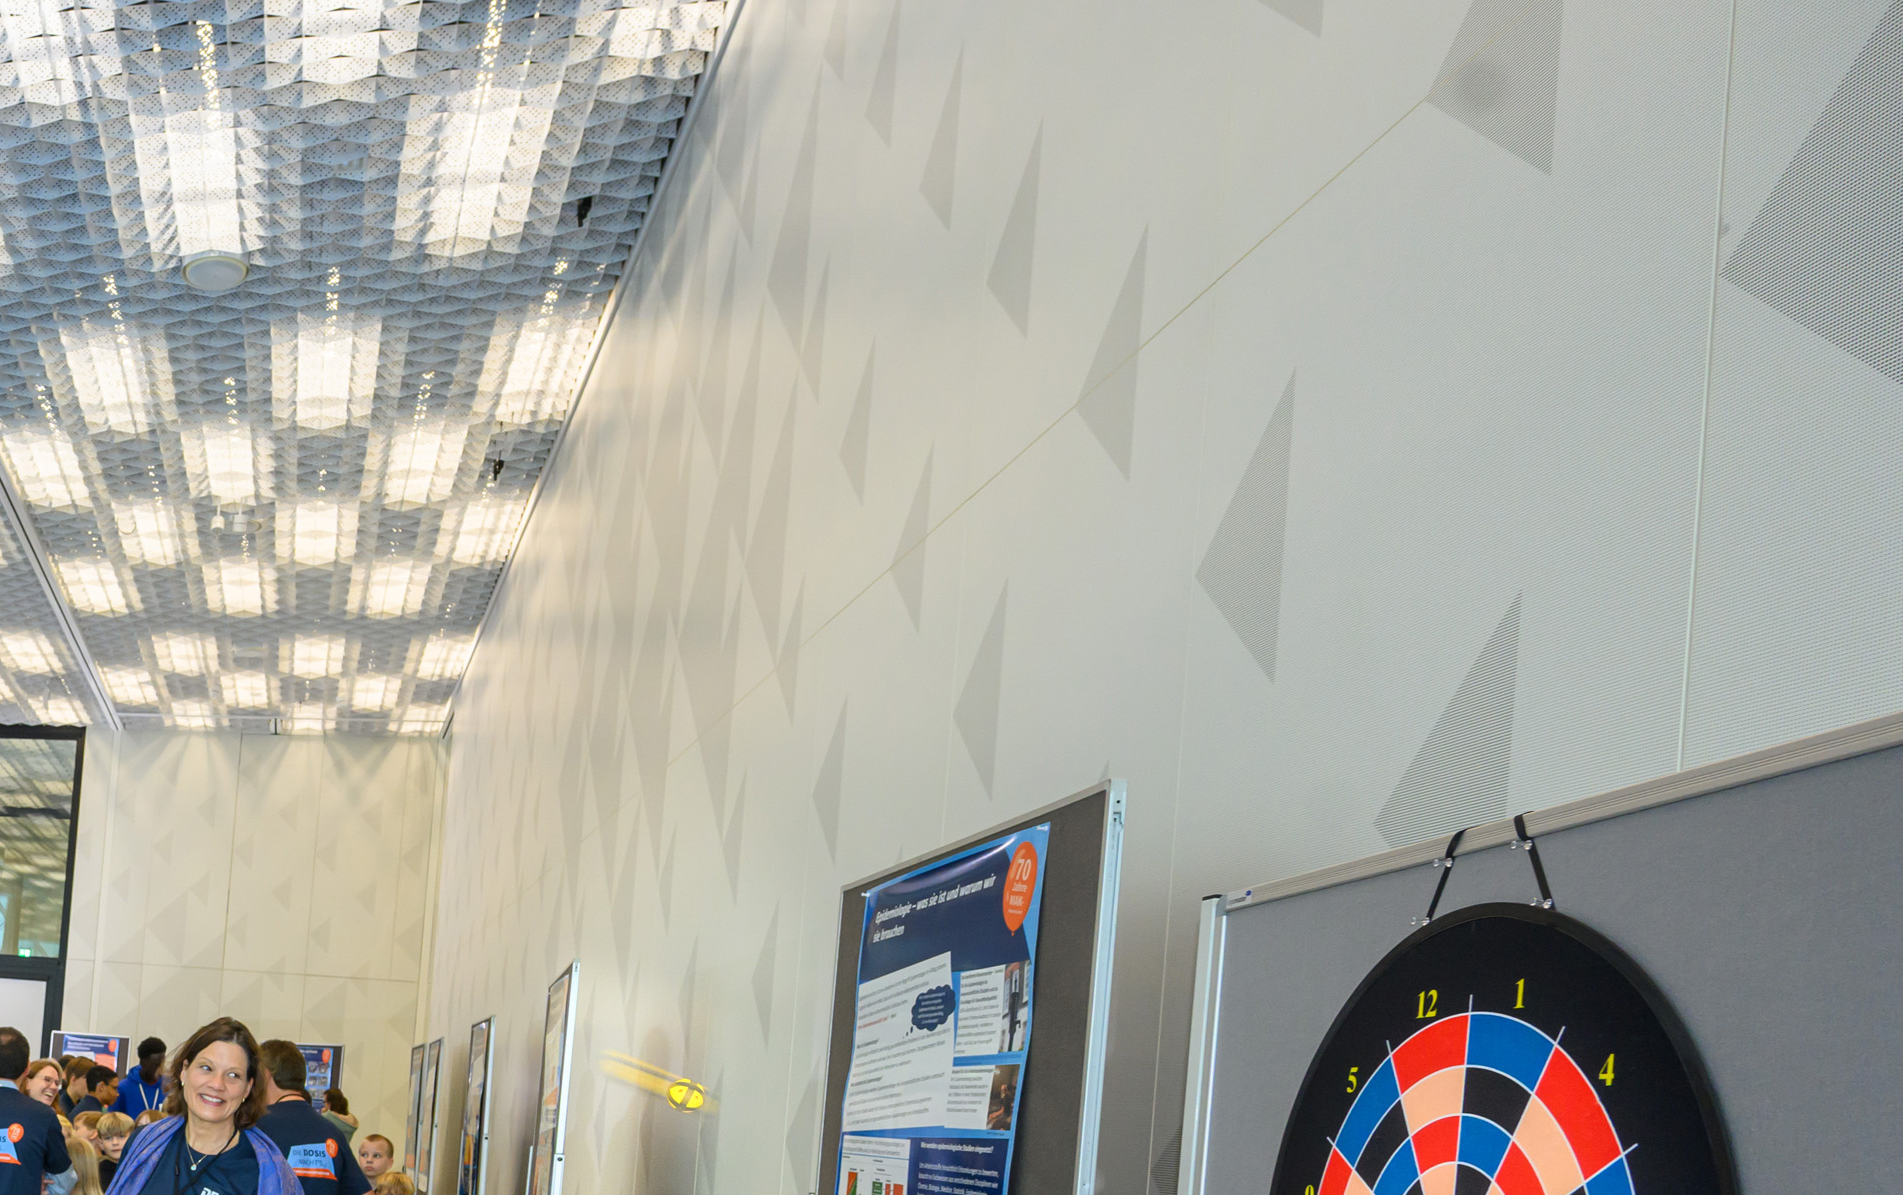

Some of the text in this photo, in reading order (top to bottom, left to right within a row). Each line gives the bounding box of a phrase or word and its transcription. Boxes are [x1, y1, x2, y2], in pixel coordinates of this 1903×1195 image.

[1016, 858, 1032, 881] 70
[875, 901, 912, 925] Epidemiologie
[916, 898, 929, 911] was
[928, 892, 938, 908] sie
[938, 889, 947, 904] ist
[946, 884, 960, 901] und
[959, 880, 983, 897] warum
[983, 873, 997, 889] wir
[873, 923, 905, 943] sie brauchen
[1415, 989, 1439, 1019] 12
[1513, 978, 1525, 1010] 1
[1346, 1067, 1359, 1093] 5
[1599, 1053, 1615, 1086] 4
[303, 1149, 326, 1157] DOSIS
